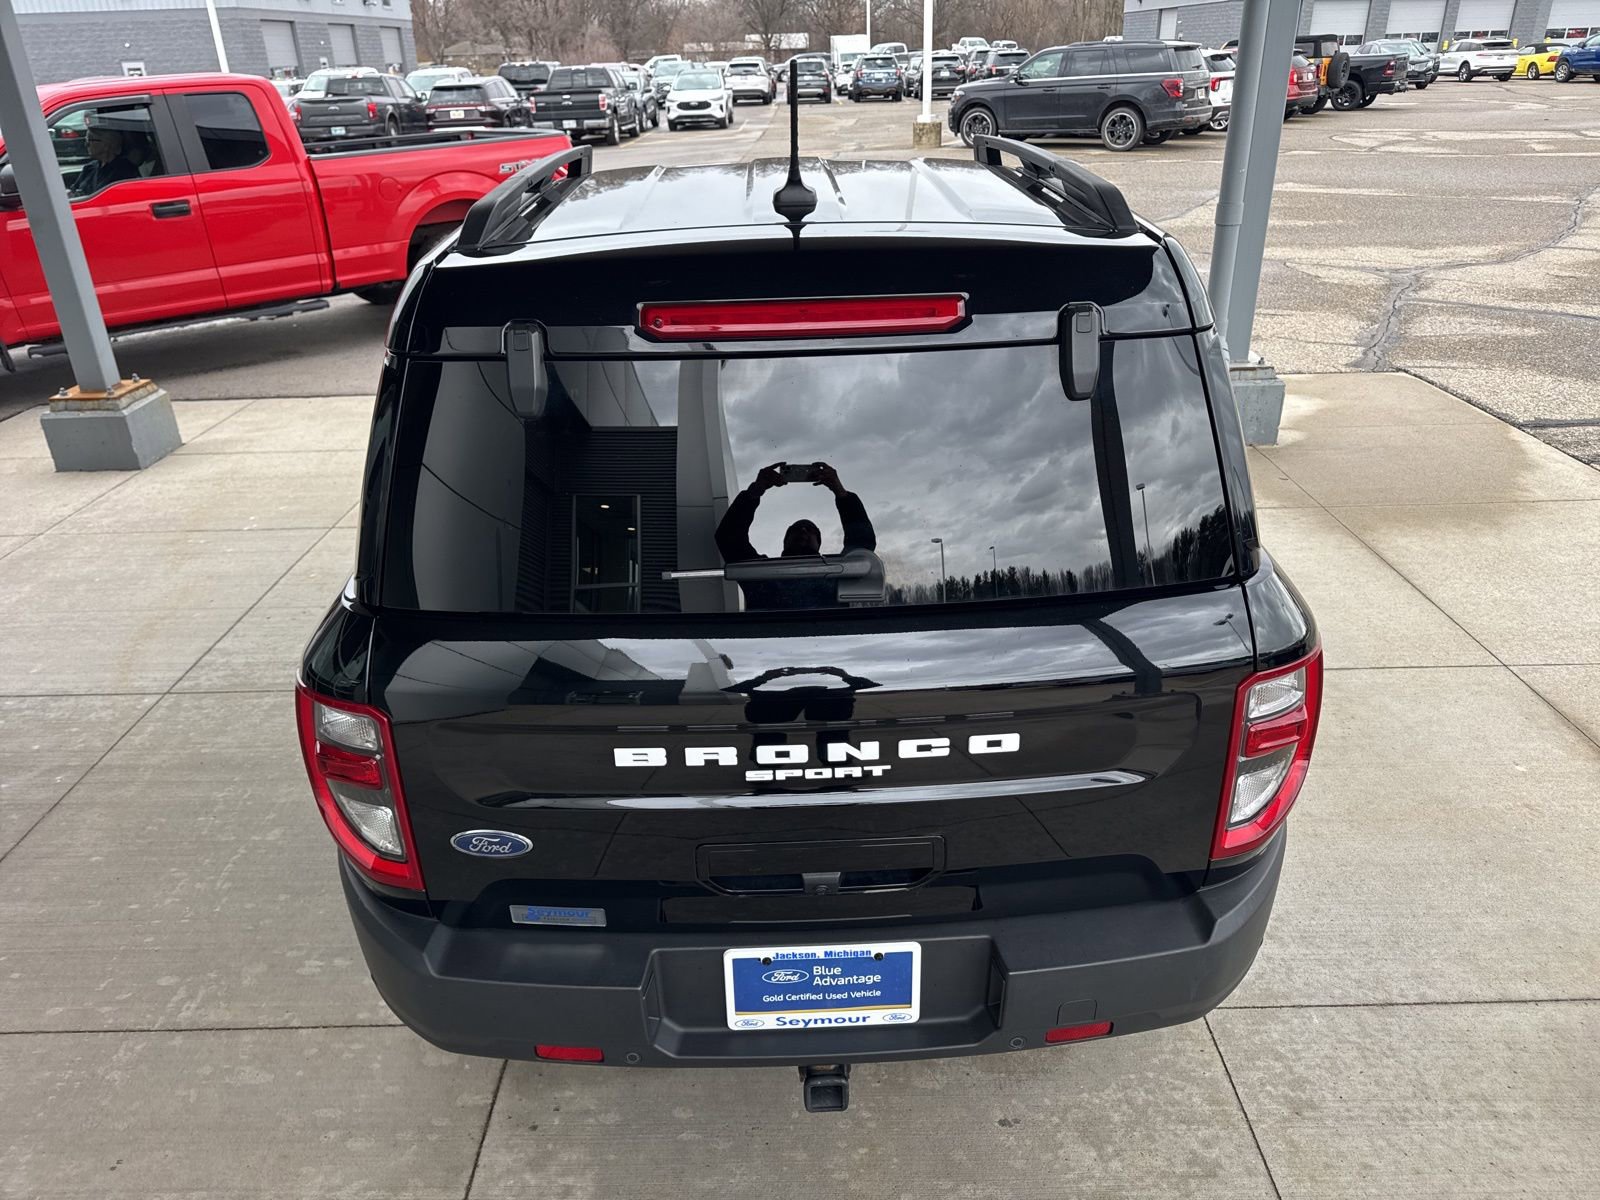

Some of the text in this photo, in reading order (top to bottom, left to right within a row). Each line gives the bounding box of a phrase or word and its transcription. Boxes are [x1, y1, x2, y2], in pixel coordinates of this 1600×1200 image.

[613, 732, 1021, 767] BRONCO
[745, 765, 891, 781] SPORT
[469, 836, 512, 853] Ford
[772, 949, 872, 960] Jackson, Michigan
[771, 970, 799, 983] Ford
[813, 965, 842, 975] Blue
[813, 974, 881, 987] Advantage
[763, 989, 881, 1002] Gold Certified Used Vehicle
[776, 1014, 870, 1028] Seymour
